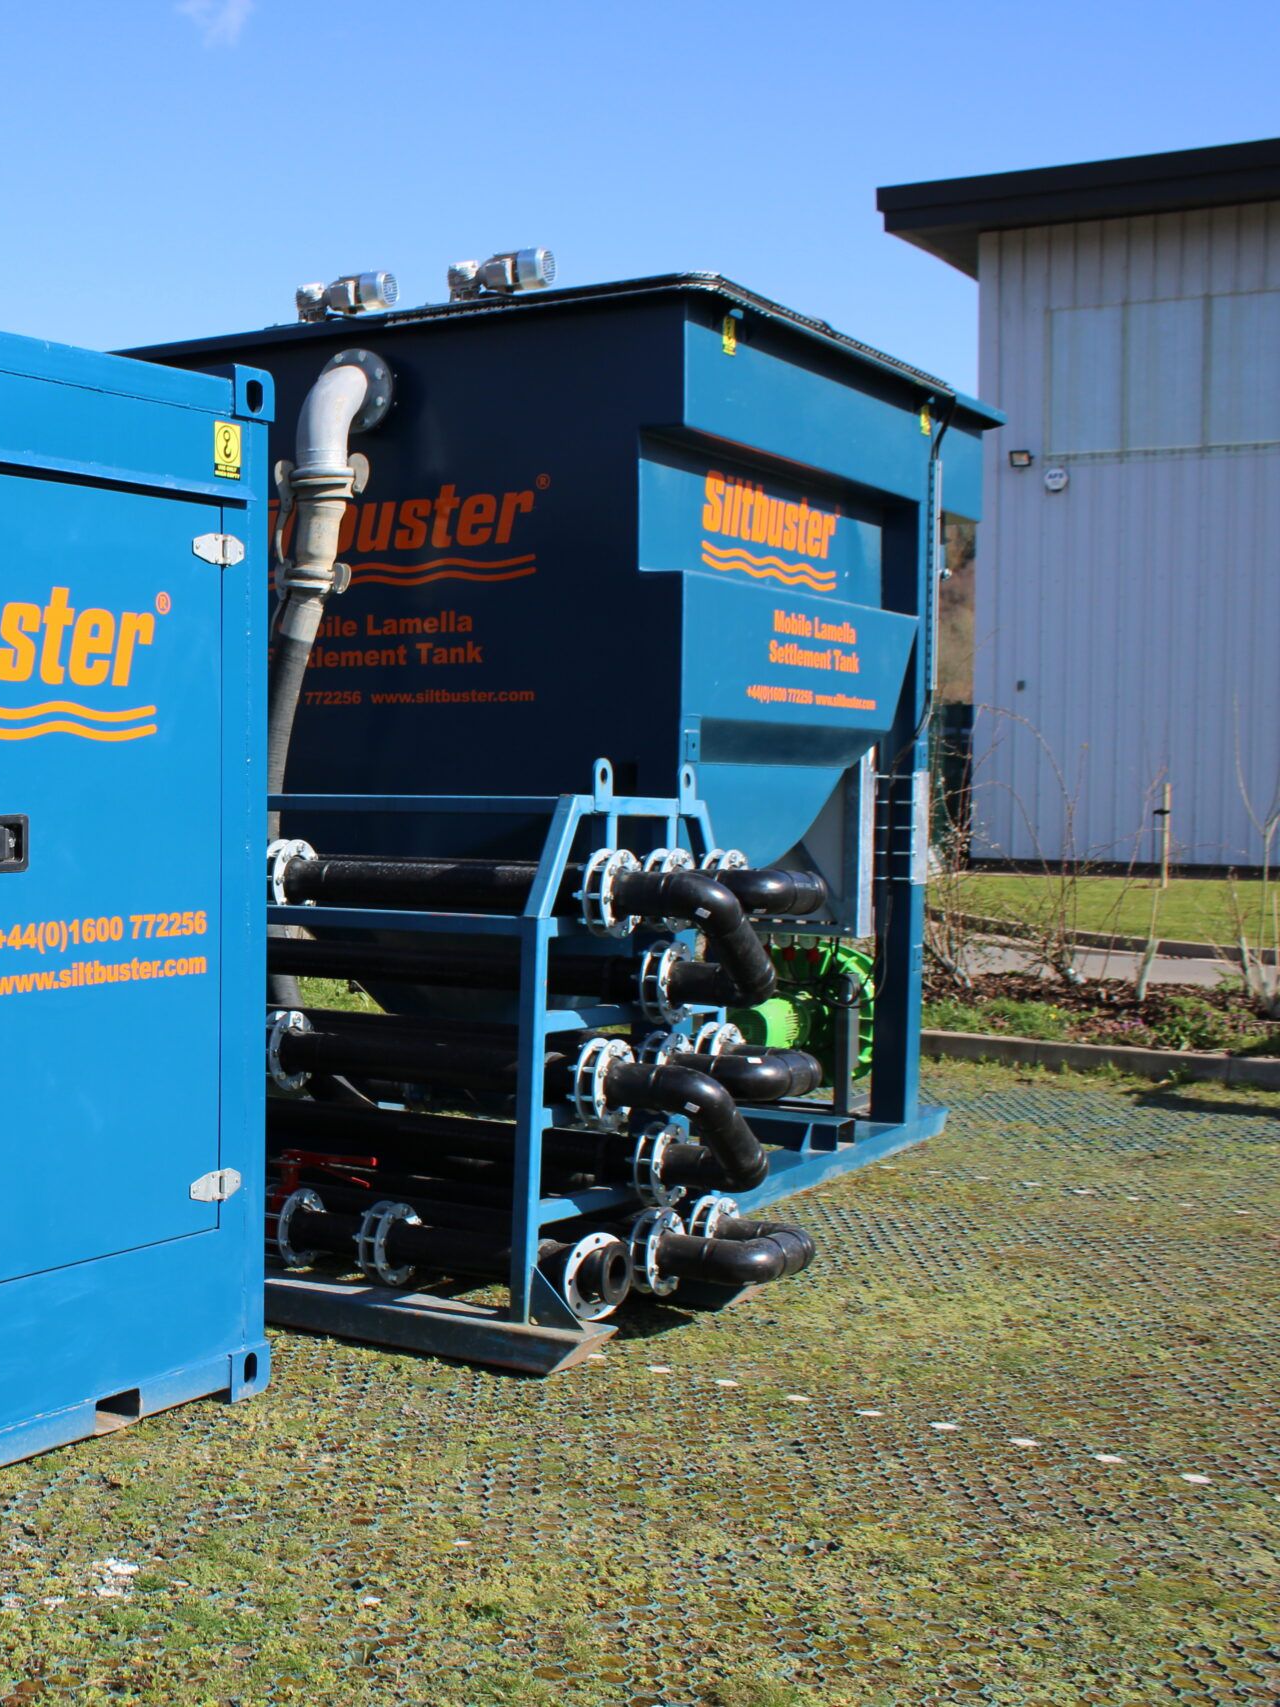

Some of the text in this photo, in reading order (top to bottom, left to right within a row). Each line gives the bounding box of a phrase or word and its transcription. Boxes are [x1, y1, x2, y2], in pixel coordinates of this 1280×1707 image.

[702, 470, 836, 560] Siltbuster
[367, 611, 473, 636] Lamella
[773, 609, 856, 645] Mobile Lamella
[416, 641, 482, 664] Tank
[769, 640, 859, 673] Settlement Tank
[305, 689, 535, 705] 772256 www.siltbuster.com
[130, 911, 208, 939] 772256
